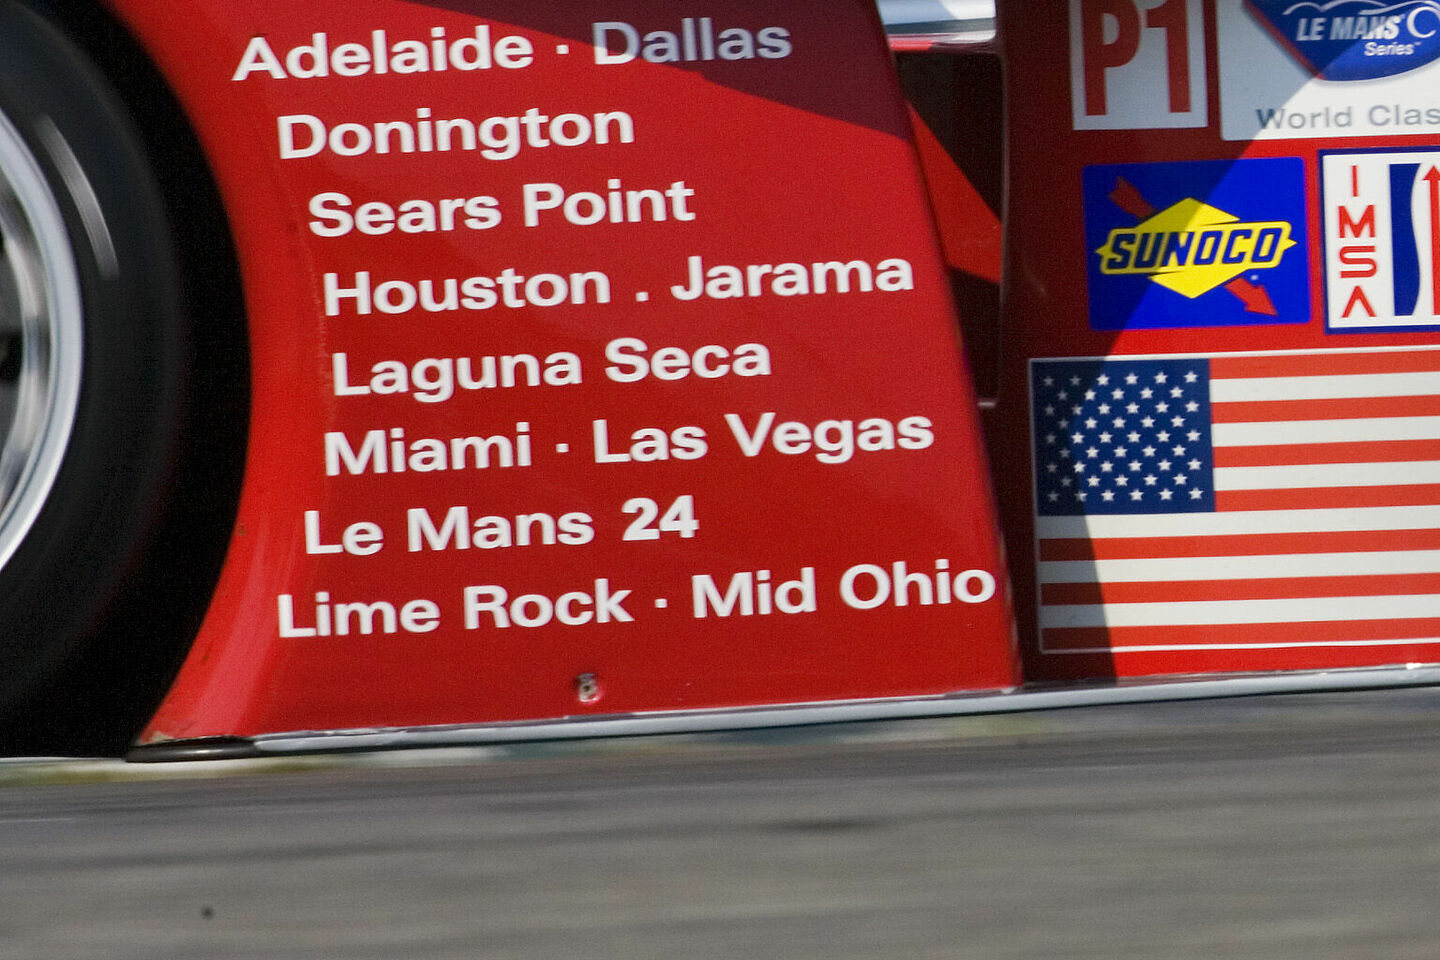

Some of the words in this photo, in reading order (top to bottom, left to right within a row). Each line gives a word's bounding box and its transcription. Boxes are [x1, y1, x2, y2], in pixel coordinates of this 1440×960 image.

[231, 24, 534, 82] Adelaide
[593, 16, 791, 65] Dallas
[1295, 16, 1325, 42] LE
[1330, 14, 1403, 41] MANS
[1363, 41, 1415, 57] Series
[277, 107, 635, 161] Donington
[1256, 105, 1353, 130] World
[308, 190, 502, 238] Sears
[522, 177, 696, 228] Point
[1106, 226, 1284, 271] SUNOCO
[1337, 165, 1378, 319] IMSA
[323, 267, 611, 317] Houston
[670, 255, 914, 301] Jarama
[332, 351, 583, 403] Laguna
[604, 337, 772, 383] Seca
[324, 421, 532, 477] Miami
[592, 419, 708, 464] Las
[723, 411, 935, 465] Vegas
[304, 510, 384, 556] Le
[407, 505, 595, 553] Mans
[621, 494, 700, 542] 24
[277, 591, 440, 639] Lime
[463, 577, 635, 630] Rock
[691, 566, 817, 619] Mid
[839, 558, 996, 610] Ohio
